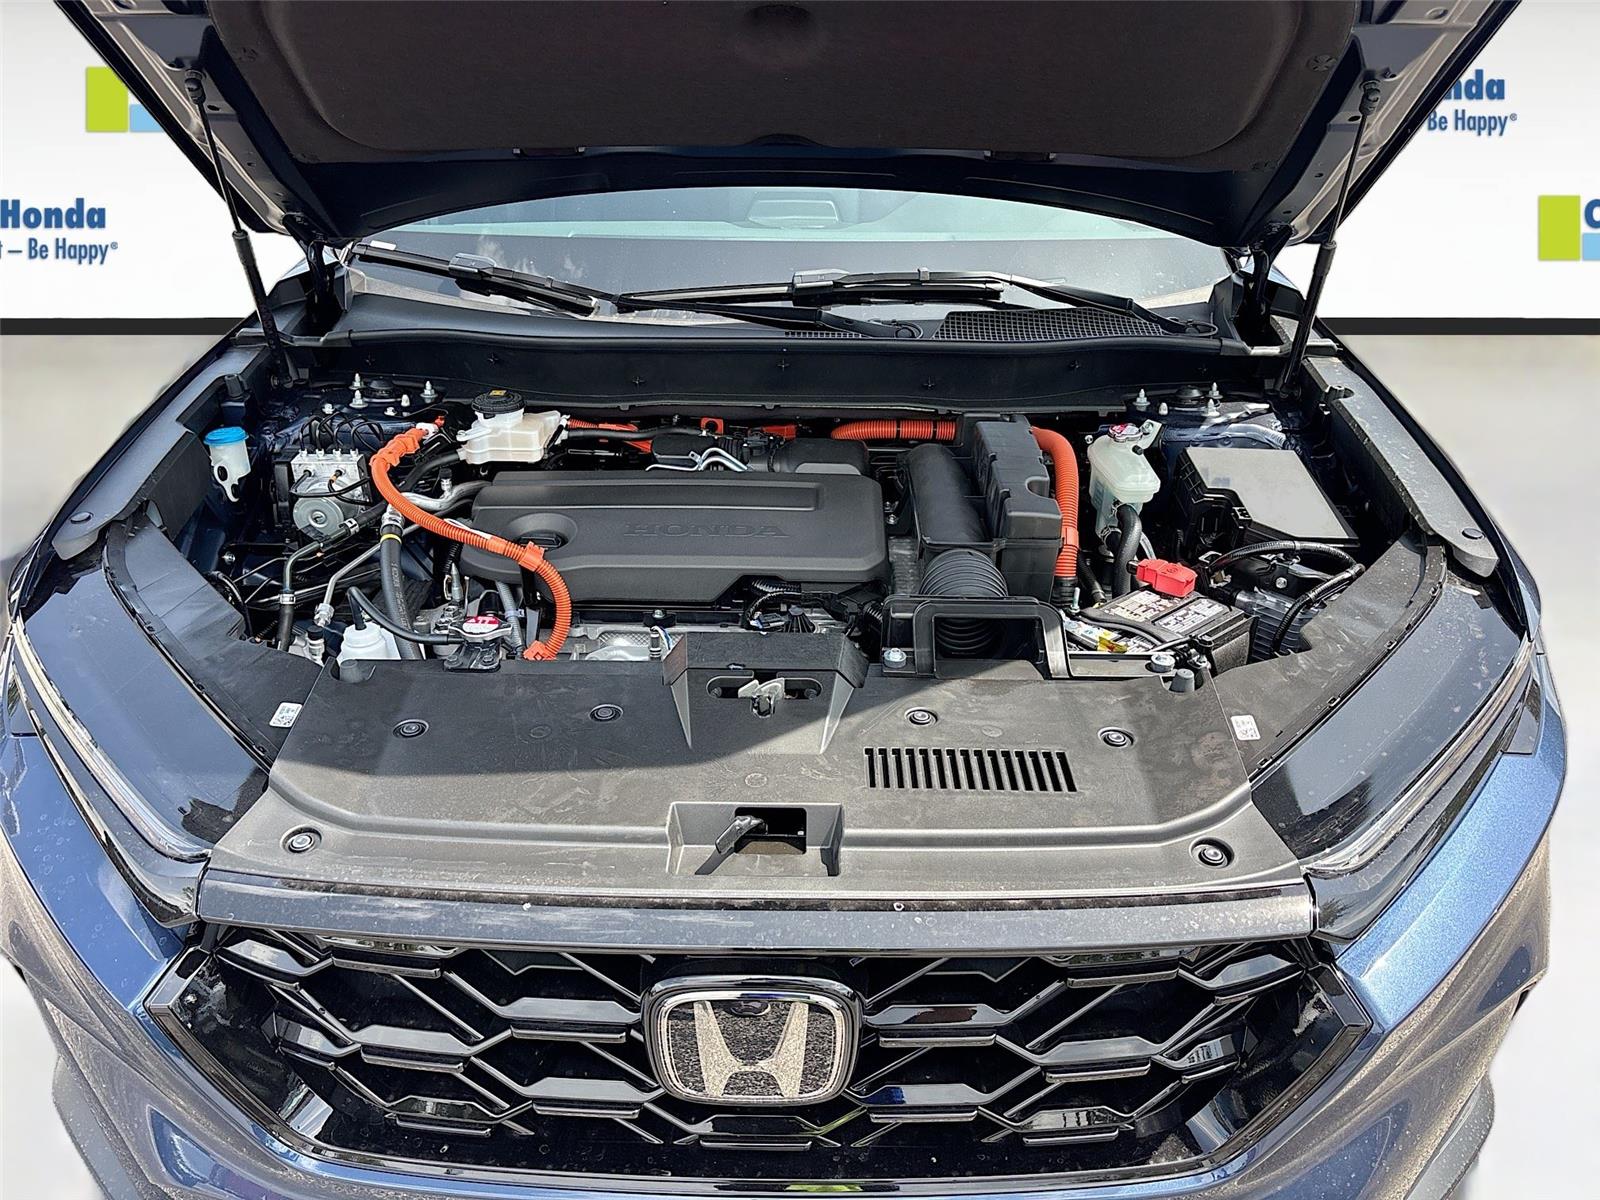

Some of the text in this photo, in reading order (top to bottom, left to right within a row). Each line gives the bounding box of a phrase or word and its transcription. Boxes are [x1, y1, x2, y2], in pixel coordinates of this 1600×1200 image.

[1444, 69, 1505, 100] nda
[1427, 110, 1448, 131] Be
[0, 198, 106, 229] Honda
[28, 237, 49, 260] Be
[623, 522, 790, 538] HONDA
